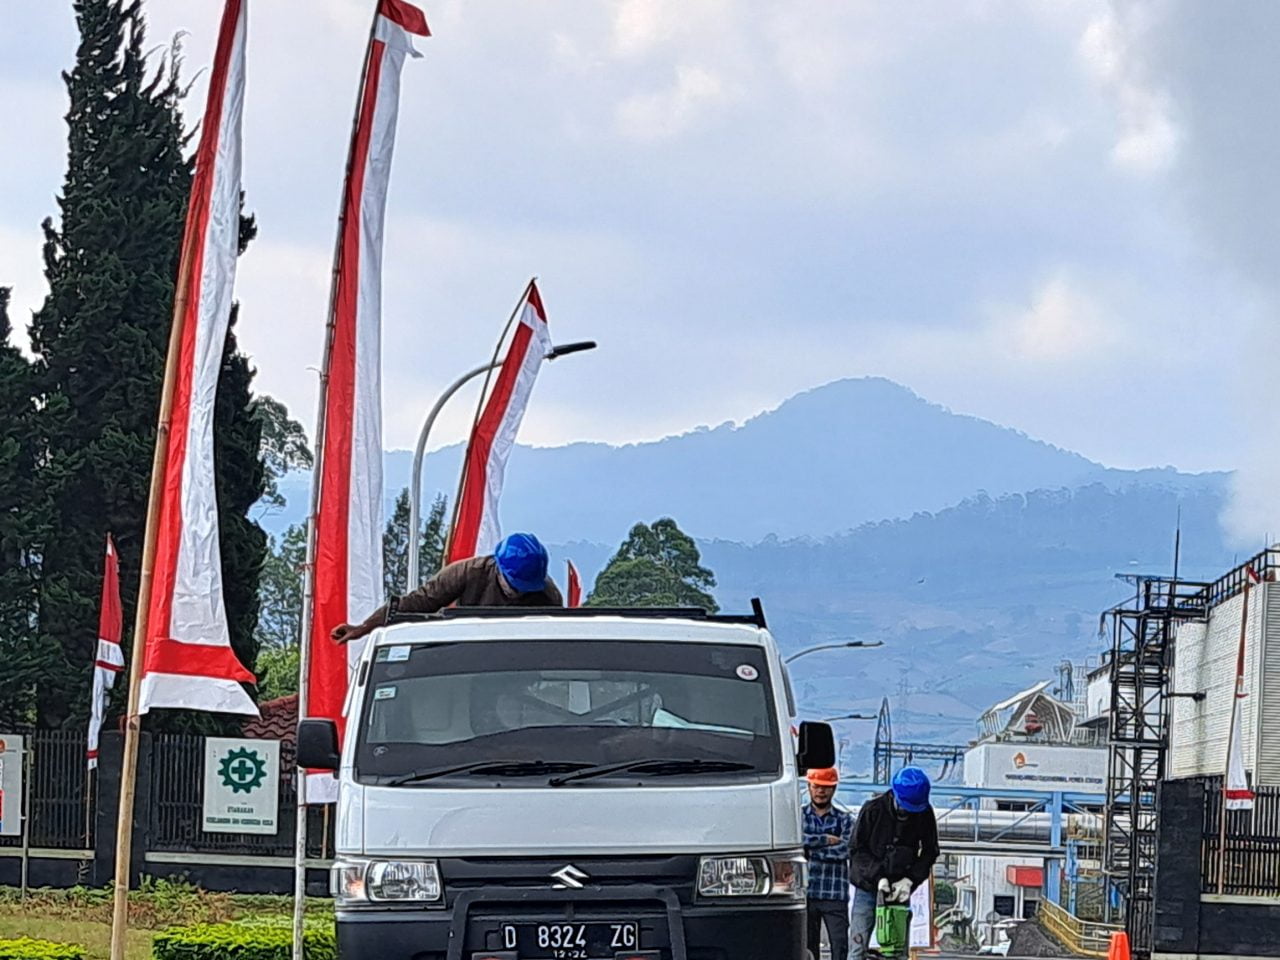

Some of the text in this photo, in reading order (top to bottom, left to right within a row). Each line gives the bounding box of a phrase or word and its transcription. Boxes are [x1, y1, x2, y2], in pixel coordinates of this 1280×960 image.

[505, 924, 635, 948] D 8324 ZG
